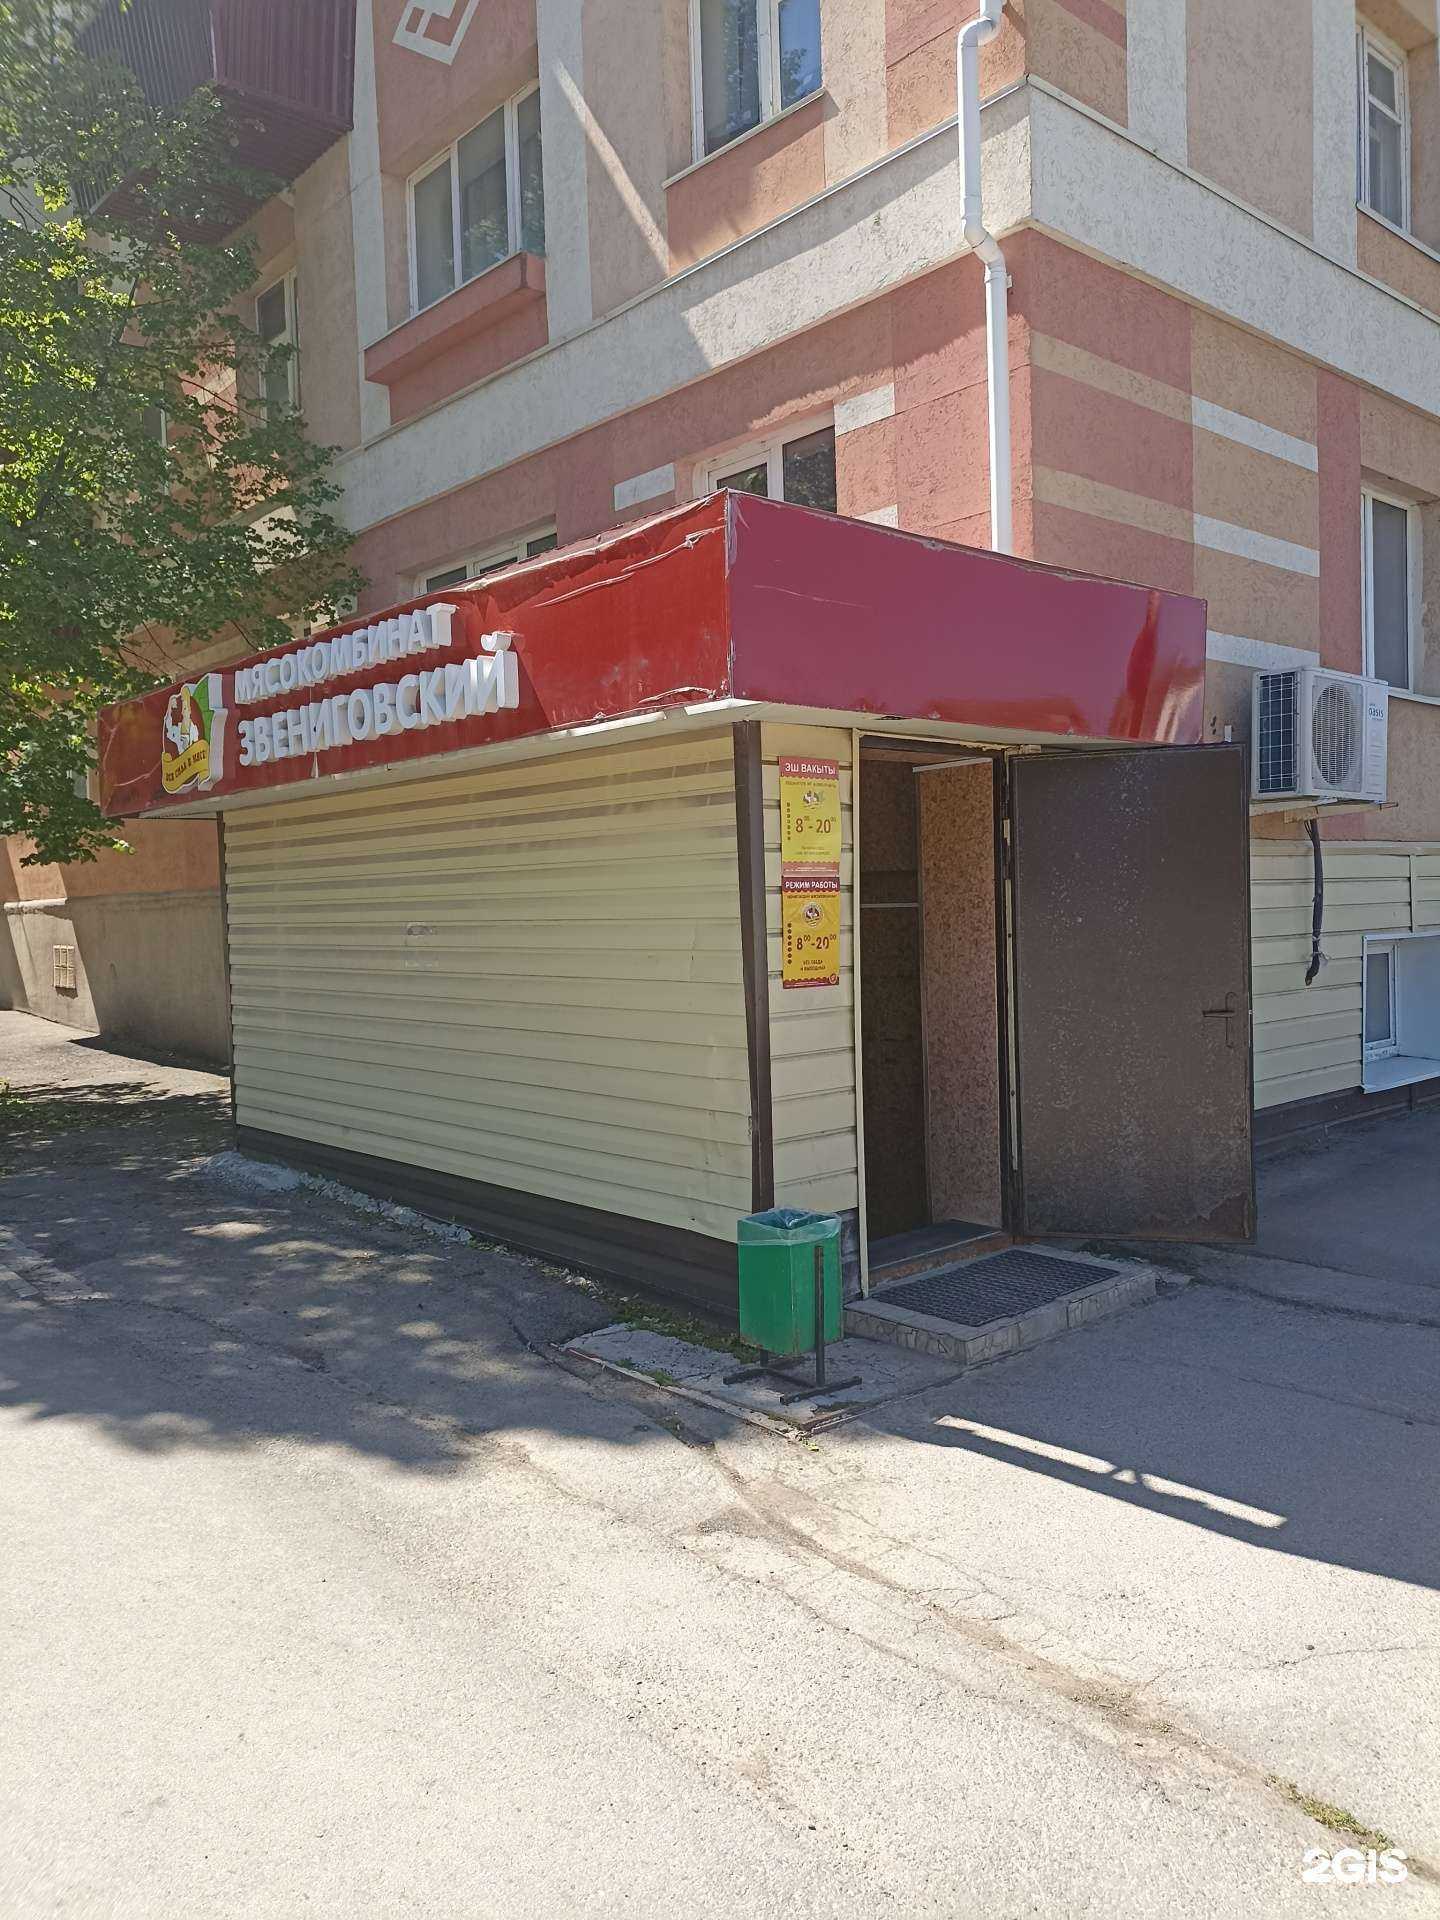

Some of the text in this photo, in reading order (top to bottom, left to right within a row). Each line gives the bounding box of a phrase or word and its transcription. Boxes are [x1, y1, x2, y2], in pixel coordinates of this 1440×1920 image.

[235, 603, 456, 704] МЯСОКОМБИНАТ
[238, 631, 519, 766] ЗВЕНИГОВСКИЙ
[785, 762, 836, 775] ЭШ ВАКЫТЫ
[785, 881, 838, 889] РЕЖИМ РАБОТЫ
